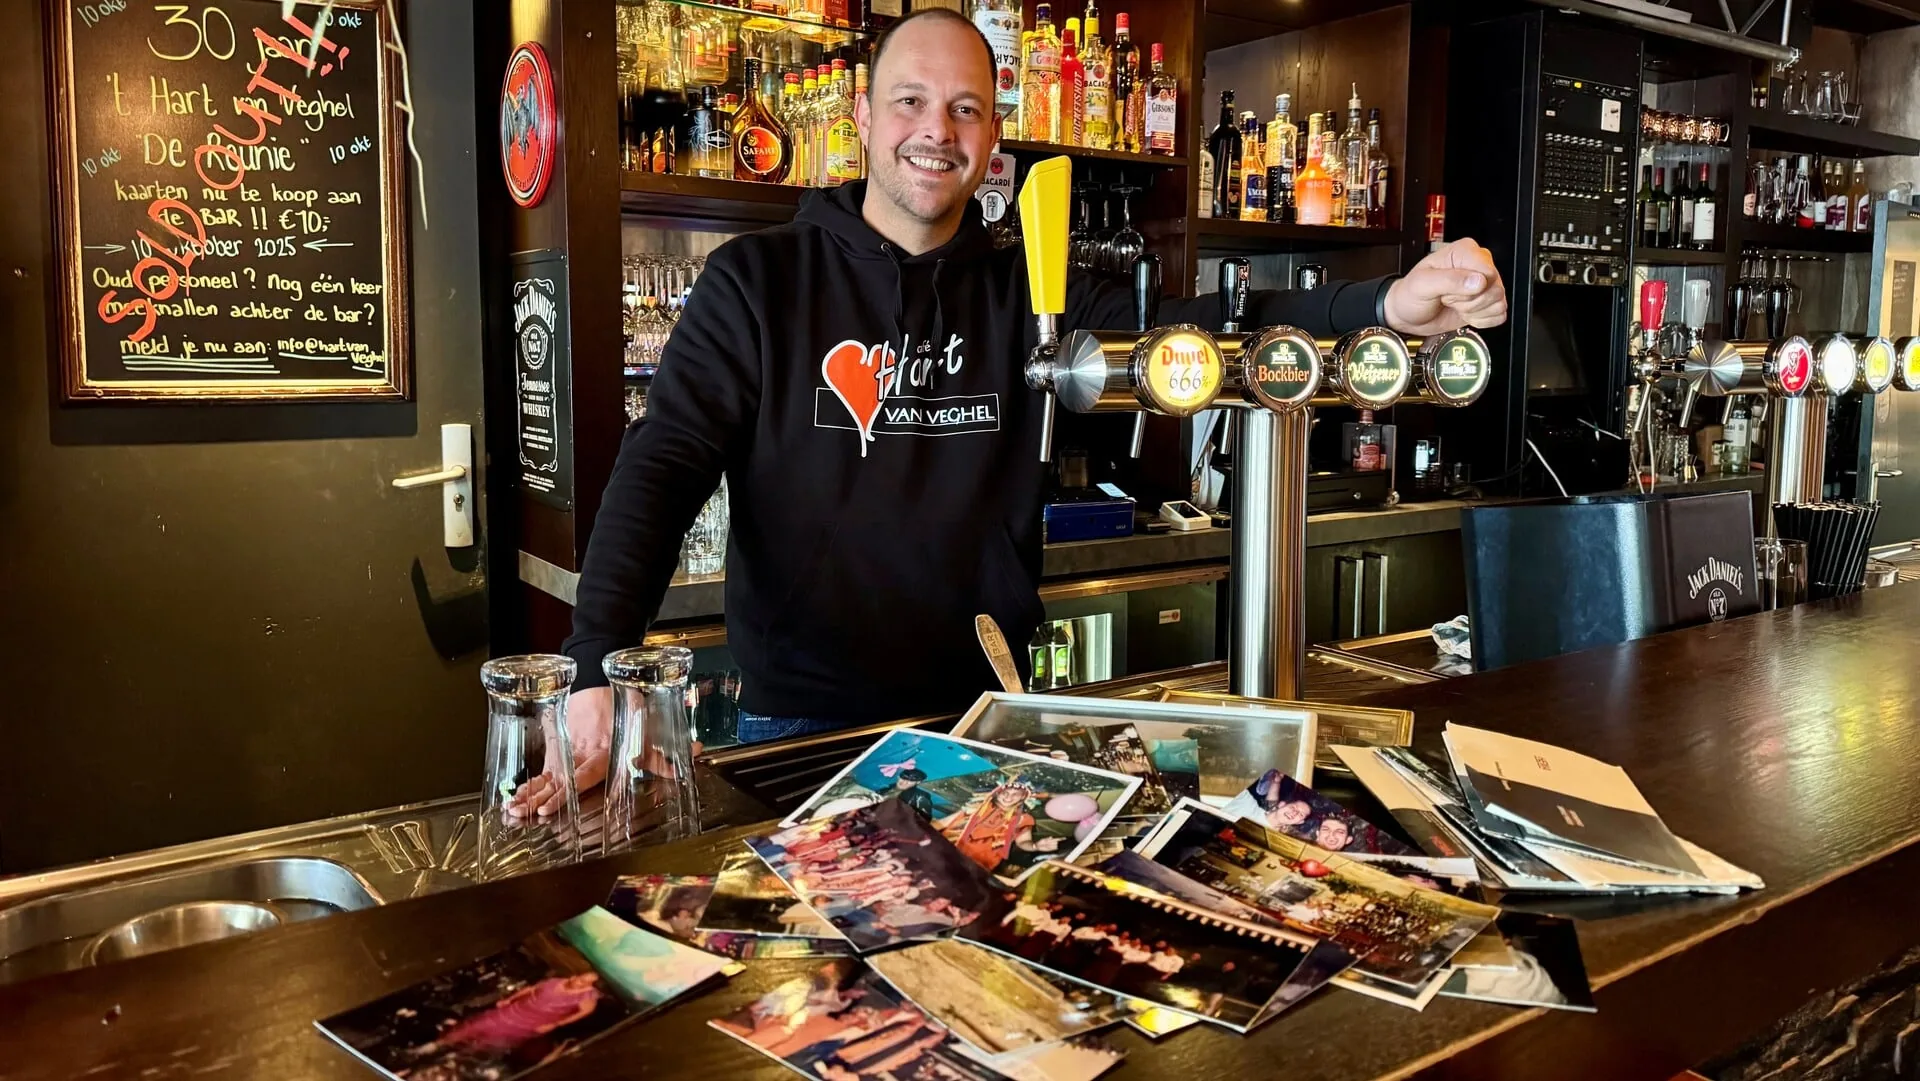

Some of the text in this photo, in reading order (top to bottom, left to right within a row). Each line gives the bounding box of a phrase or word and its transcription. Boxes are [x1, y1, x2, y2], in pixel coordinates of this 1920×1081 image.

[77, 0, 127, 28] 10 okt
[339, 12, 362, 28] okt
[147, 6, 236, 60] 30
[106, 72, 131, 116] 't
[150, 76, 218, 116] Hart
[82, 147, 122, 178] 10 okt
[329, 136, 371, 164] 10 okt
[743, 146, 775, 155] SAFARI
[114, 179, 361, 207] kaarten nu te koop aan
[983, 176, 1010, 187] ACARDÍ
[255, 236, 296, 257] 2025
[93, 267, 133, 288] Oud
[149, 272, 238, 294] pesoneel
[351, 277, 383, 294] keer
[230, 302, 293, 319] achter
[304, 304, 327, 321] de
[120, 335, 169, 355] meld
[180, 334, 199, 360] je
[204, 344, 228, 353] nu
[1258, 365, 1310, 382] Bockbier
[523, 402, 551, 418] WHISKEY
[885, 405, 995, 425] VAN VEGHEL
[1687, 556, 1743, 599] JACK DANIEL'S
